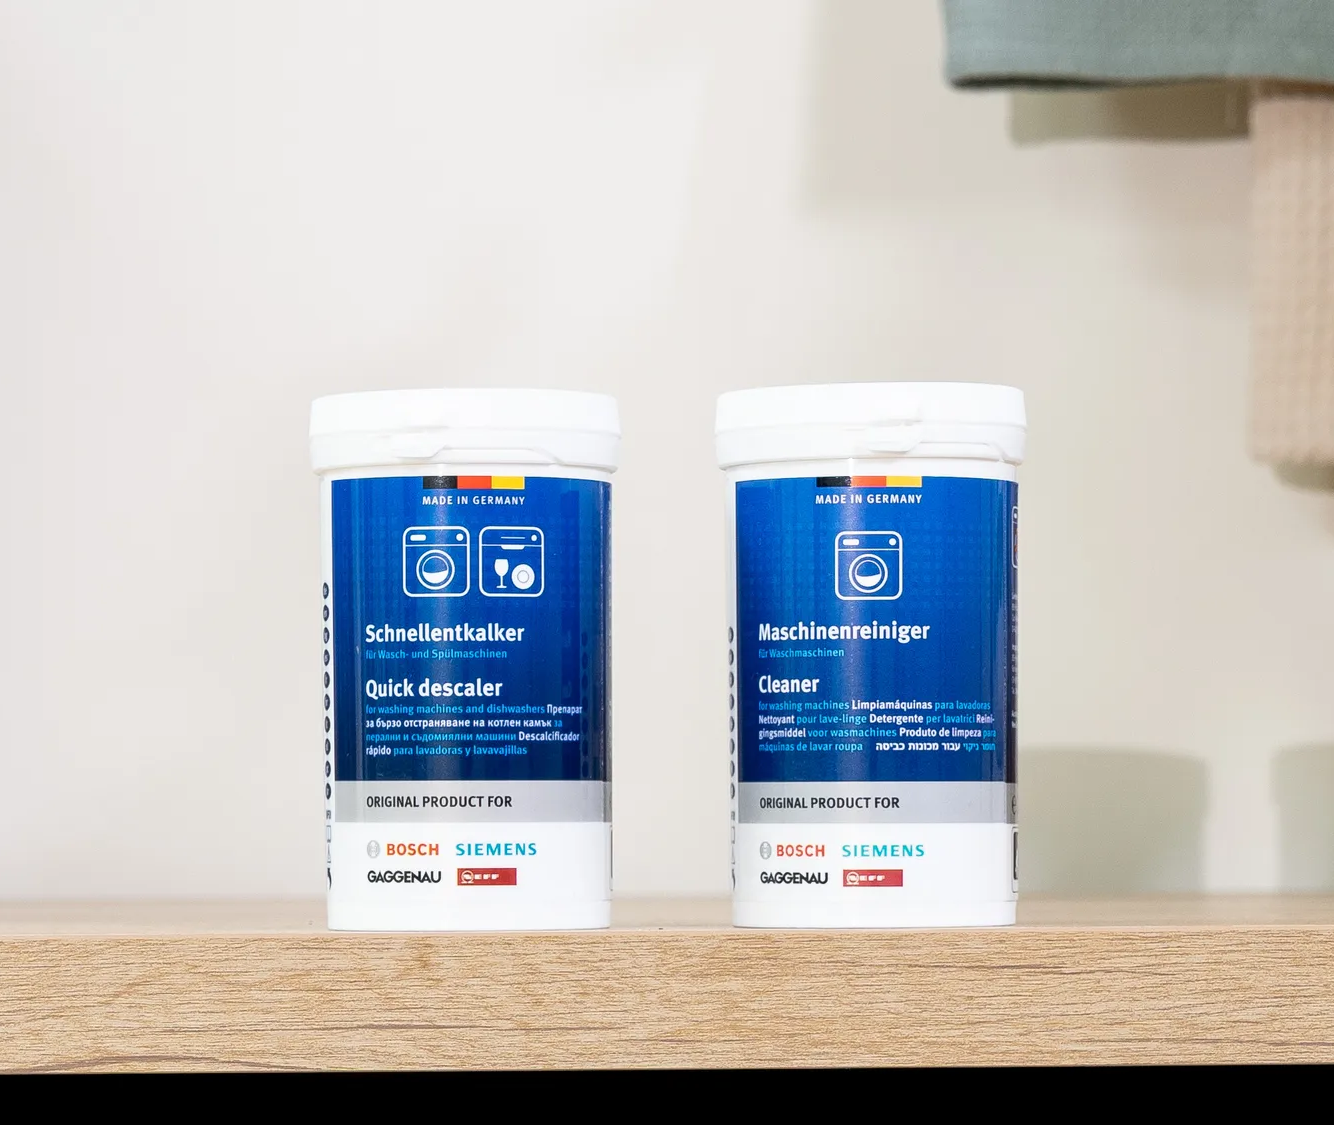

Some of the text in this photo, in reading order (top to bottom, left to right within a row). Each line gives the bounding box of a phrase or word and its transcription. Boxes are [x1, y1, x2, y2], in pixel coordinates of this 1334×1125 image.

[422, 496, 525, 505] MADE IN GERMANY
[815, 494, 922, 504] MADE IN GERMANY
[365, 623, 525, 643] Schnellentkalker
[759, 620, 930, 643] Maschinenreiniger
[366, 648, 507, 660] für Wasch- und Spülmaschinen
[759, 647, 844, 658] für Waschmaschinen
[365, 677, 503, 700] Quick descaler
[759, 675, 819, 693] Cleaner
[366, 704, 545, 716] for washing machines and dishwashers
[547, 704, 583, 716] Препарат
[768, 701, 803, 712] washing
[805, 700, 849, 710] machines
[852, 699, 933, 711] Limpiamáquinas
[934, 702, 954, 711] para
[956, 700, 991, 710] lavadoras
[365, 720, 374, 728] за
[376, 718, 402, 730] бързо
[403, 720, 471, 729] отстраняване
[759, 715, 795, 726] Nettoyant
[797, 715, 817, 726] pour
[819, 714, 867, 725] lave-linge
[869, 714, 924, 725] Detergente
[926, 715, 941, 725] per
[943, 714, 975, 723] lavatrici
[475, 733, 516, 741] машини
[518, 731, 580, 741] Descalcificador
[759, 728, 806, 740] gingsmiddel
[830, 728, 897, 737] wasmachines
[899, 727, 937, 737] Produto
[939, 727, 950, 737] de
[952, 727, 981, 739] limpeza
[983, 730, 996, 739] para
[366, 745, 527, 757] rápido para lavadoras y lavavajillas
[797, 741, 807, 751] de
[809, 741, 832, 751] lavar
[835, 743, 863, 752] roupa
[366, 796, 513, 808] ORIGINAL PRODUCT FOR
[760, 797, 900, 809] ORIGINAL PRODUCT FOR
[386, 843, 537, 856] BOSCH SIEMENS
[776, 844, 925, 857] BOSCH SIEMENS
[367, 870, 442, 883] GAGGENAU
[760, 871, 828, 884] GAGGENAU
